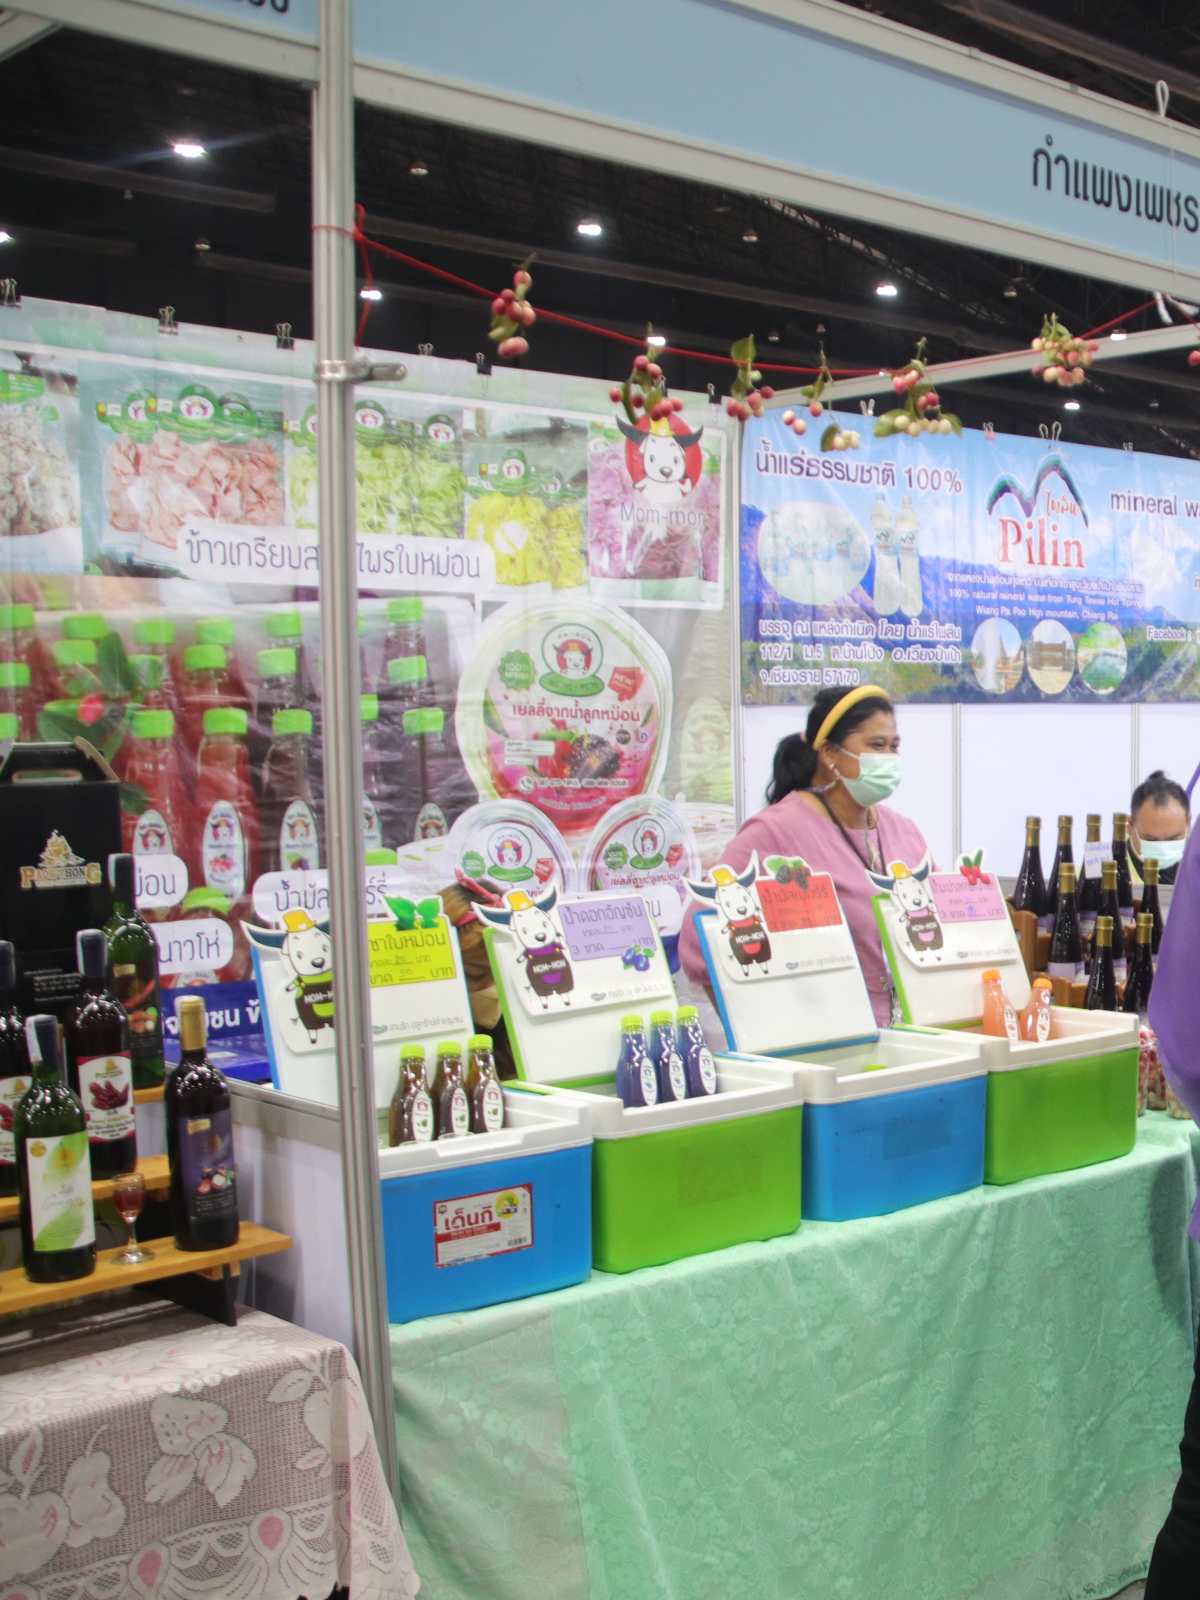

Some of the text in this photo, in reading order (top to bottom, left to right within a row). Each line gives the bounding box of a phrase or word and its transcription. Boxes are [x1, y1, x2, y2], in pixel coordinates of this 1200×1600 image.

[1033, 134, 1199, 233] กำแพงเพชร
[756, 439, 962, 493] น้ำแร่ธรรมชาติ 100%
[620, 502, 706, 526] Mom-mon
[1110, 490, 1177, 516] mineral
[999, 517, 1086, 569] Pilin
[972, 590, 998, 600] natural
[1000, 591, 1025, 601] mineral
[1028, 594, 1045, 602] water
[1047, 594, 1064, 603] from
[1121, 597, 1143, 608] Spring
[976, 605, 999, 617] Wiang
[1001, 606, 1011, 615] Pa
[1013, 607, 1026, 616] Pao
[1029, 607, 1044, 618] High
[1082, 609, 1105, 620] Chiang
[1107, 609, 1119, 620] Rai
[759, 620, 791, 638] บรรจุ
[813, 619, 875, 639] แหล่งกำเนิด
[879, 620, 904, 638] โดย
[908, 619, 962, 641] น้ำแร่ไพลิน
[1147, 626, 1186, 640] Facebook
[760, 644, 792, 660] 112/1
[804, 644, 823, 660] ม.5
[760, 665, 859, 686] จ.เชียงราย 57170
[513, 698, 641, 725] เยลลี่จากน้ำลูกหม่อน
[564, 902, 643, 925] น้ำดอกอัญชัน
[571, 945, 580, 954] 3
[584, 942, 604, 953] ขวด
[430, 966, 453, 978] บาท
